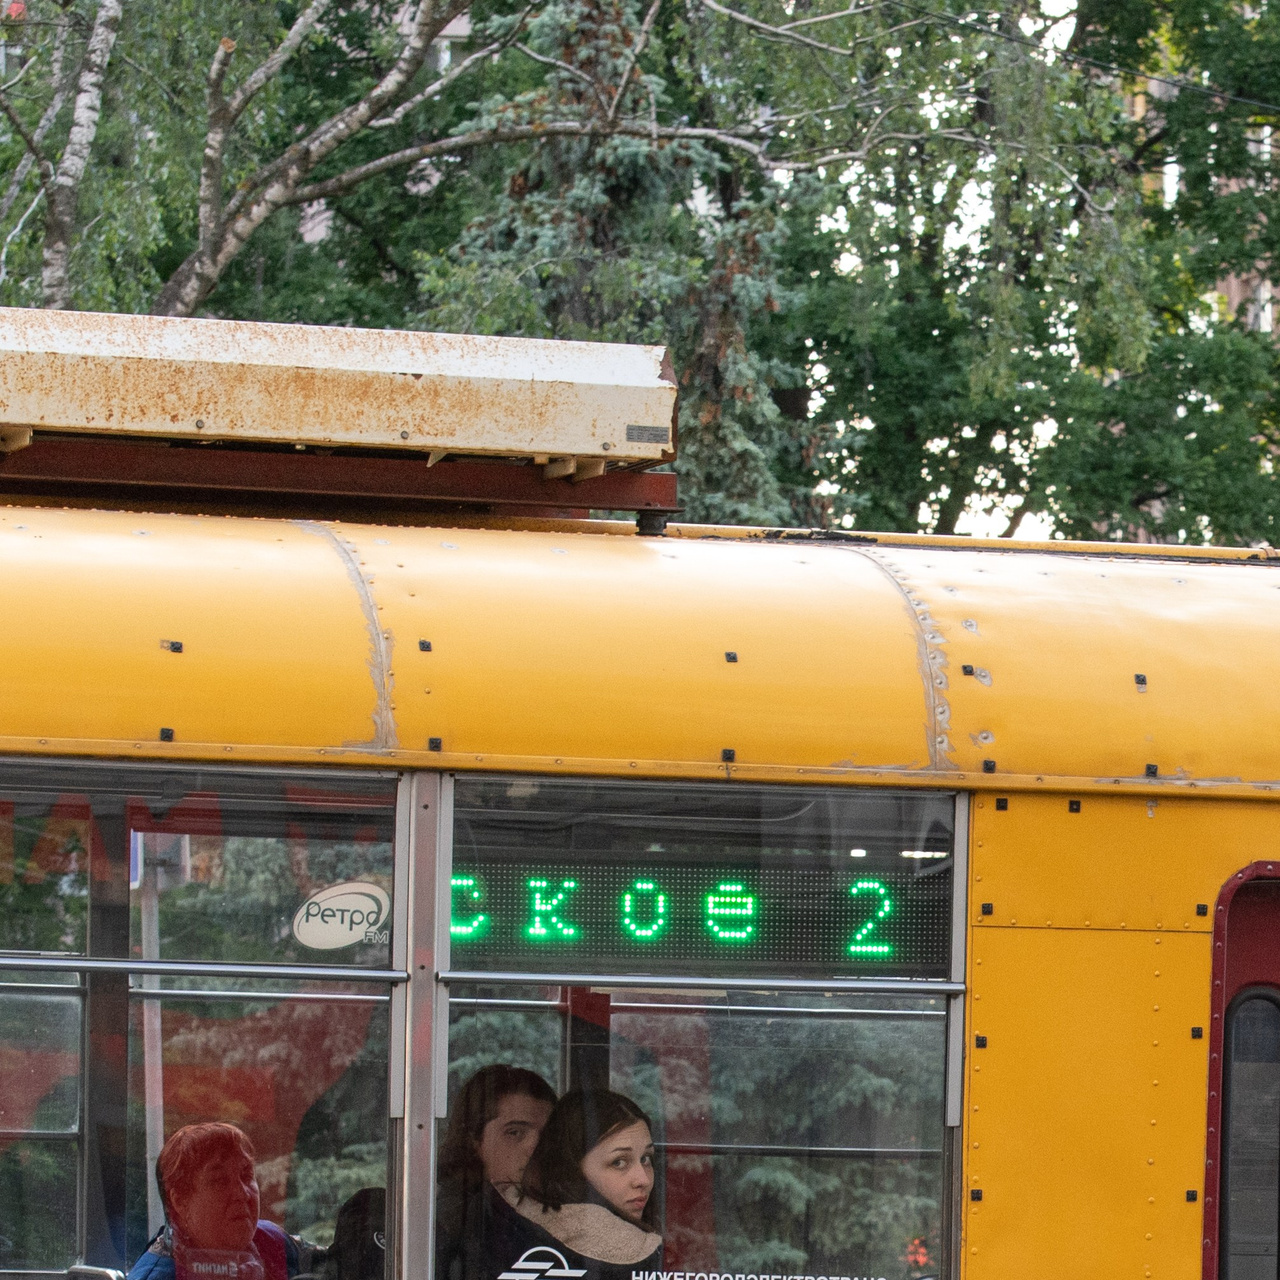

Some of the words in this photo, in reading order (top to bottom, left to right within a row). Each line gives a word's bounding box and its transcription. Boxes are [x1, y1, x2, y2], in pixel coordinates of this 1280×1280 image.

[305, 901, 381, 932] Ретро
[850, 881, 892, 953] 2
[363, 930, 389, 944] FM
